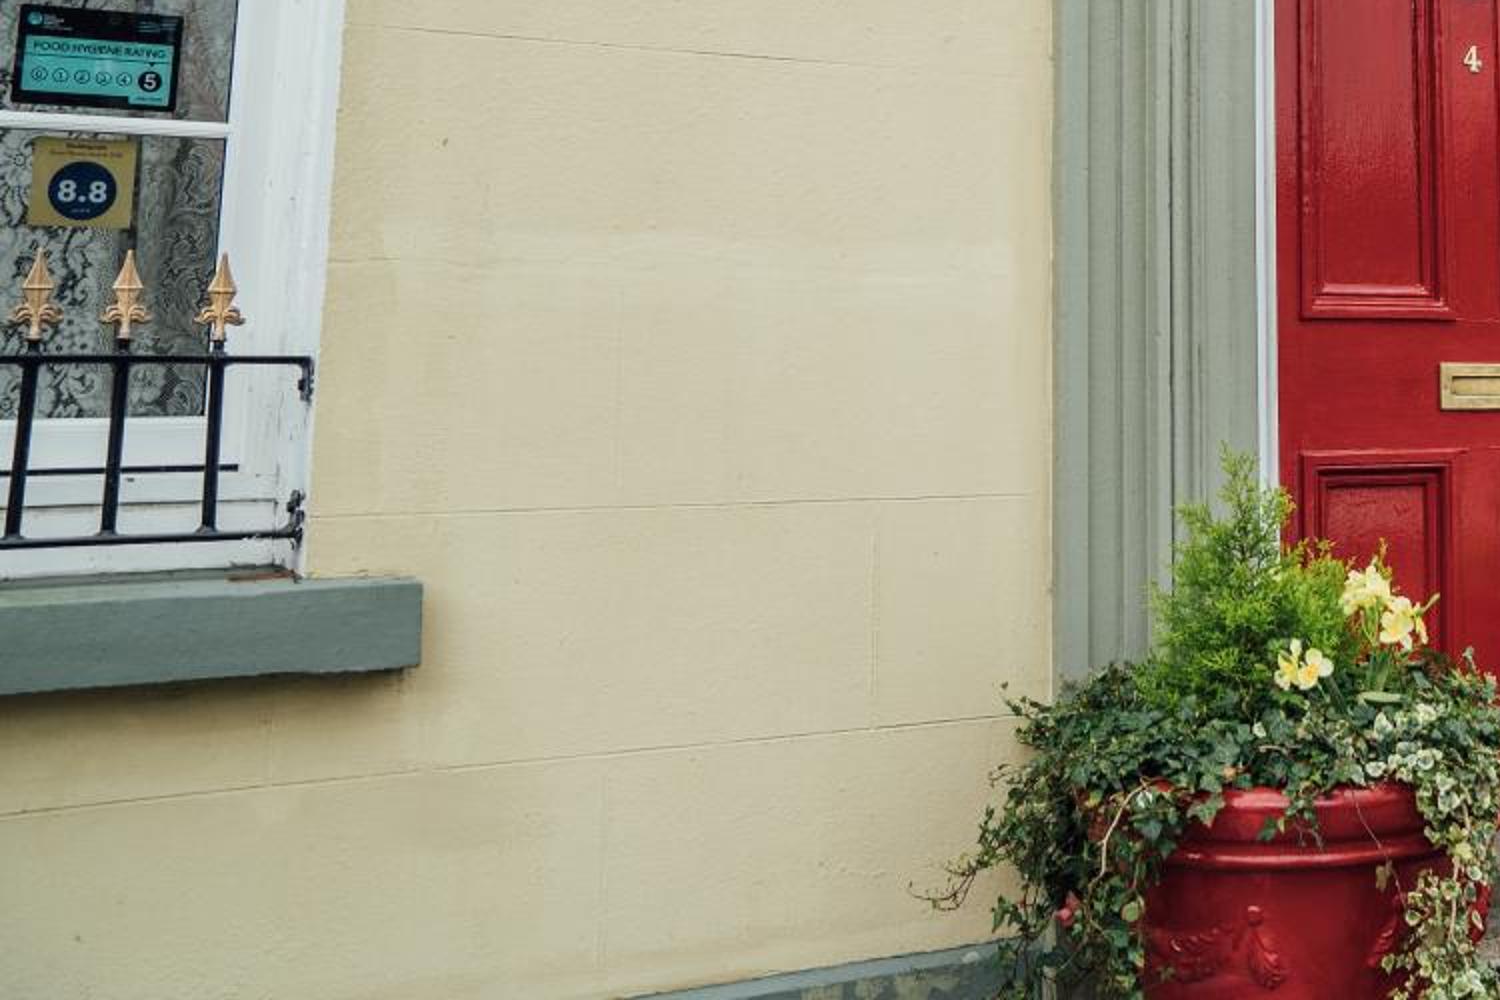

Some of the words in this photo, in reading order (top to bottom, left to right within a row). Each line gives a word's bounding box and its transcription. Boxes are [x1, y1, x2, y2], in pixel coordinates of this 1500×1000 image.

[33, 41, 70, 51] FOOD
[72, 43, 123, 56] HYGIENE
[124, 46, 166, 59] RATING
[1463, 45, 1482, 74] 4
[143, 74, 157, 90] 5
[57, 179, 107, 203] 8.8
